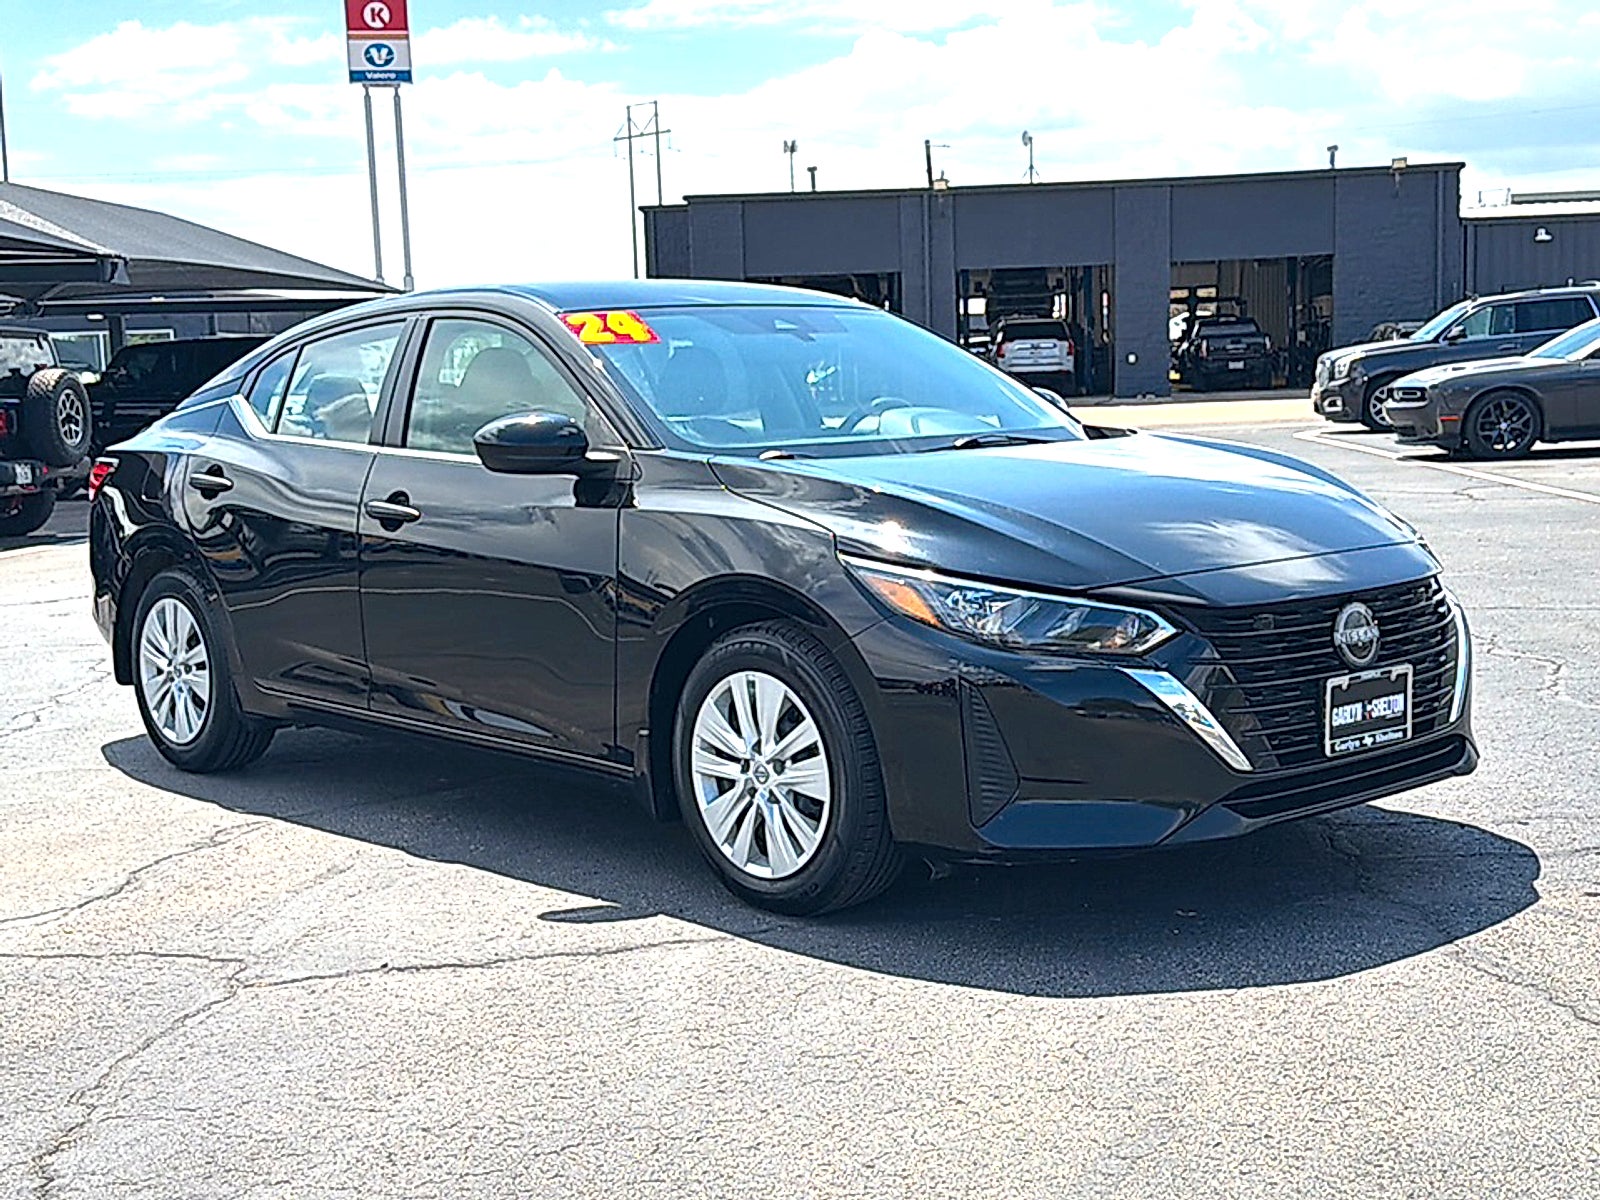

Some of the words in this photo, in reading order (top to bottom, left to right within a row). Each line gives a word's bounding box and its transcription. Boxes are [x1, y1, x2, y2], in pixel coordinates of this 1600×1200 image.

[365, 71, 397, 80] Valero
[566, 311, 652, 342] 24
[1337, 627, 1379, 643] NISSAN
